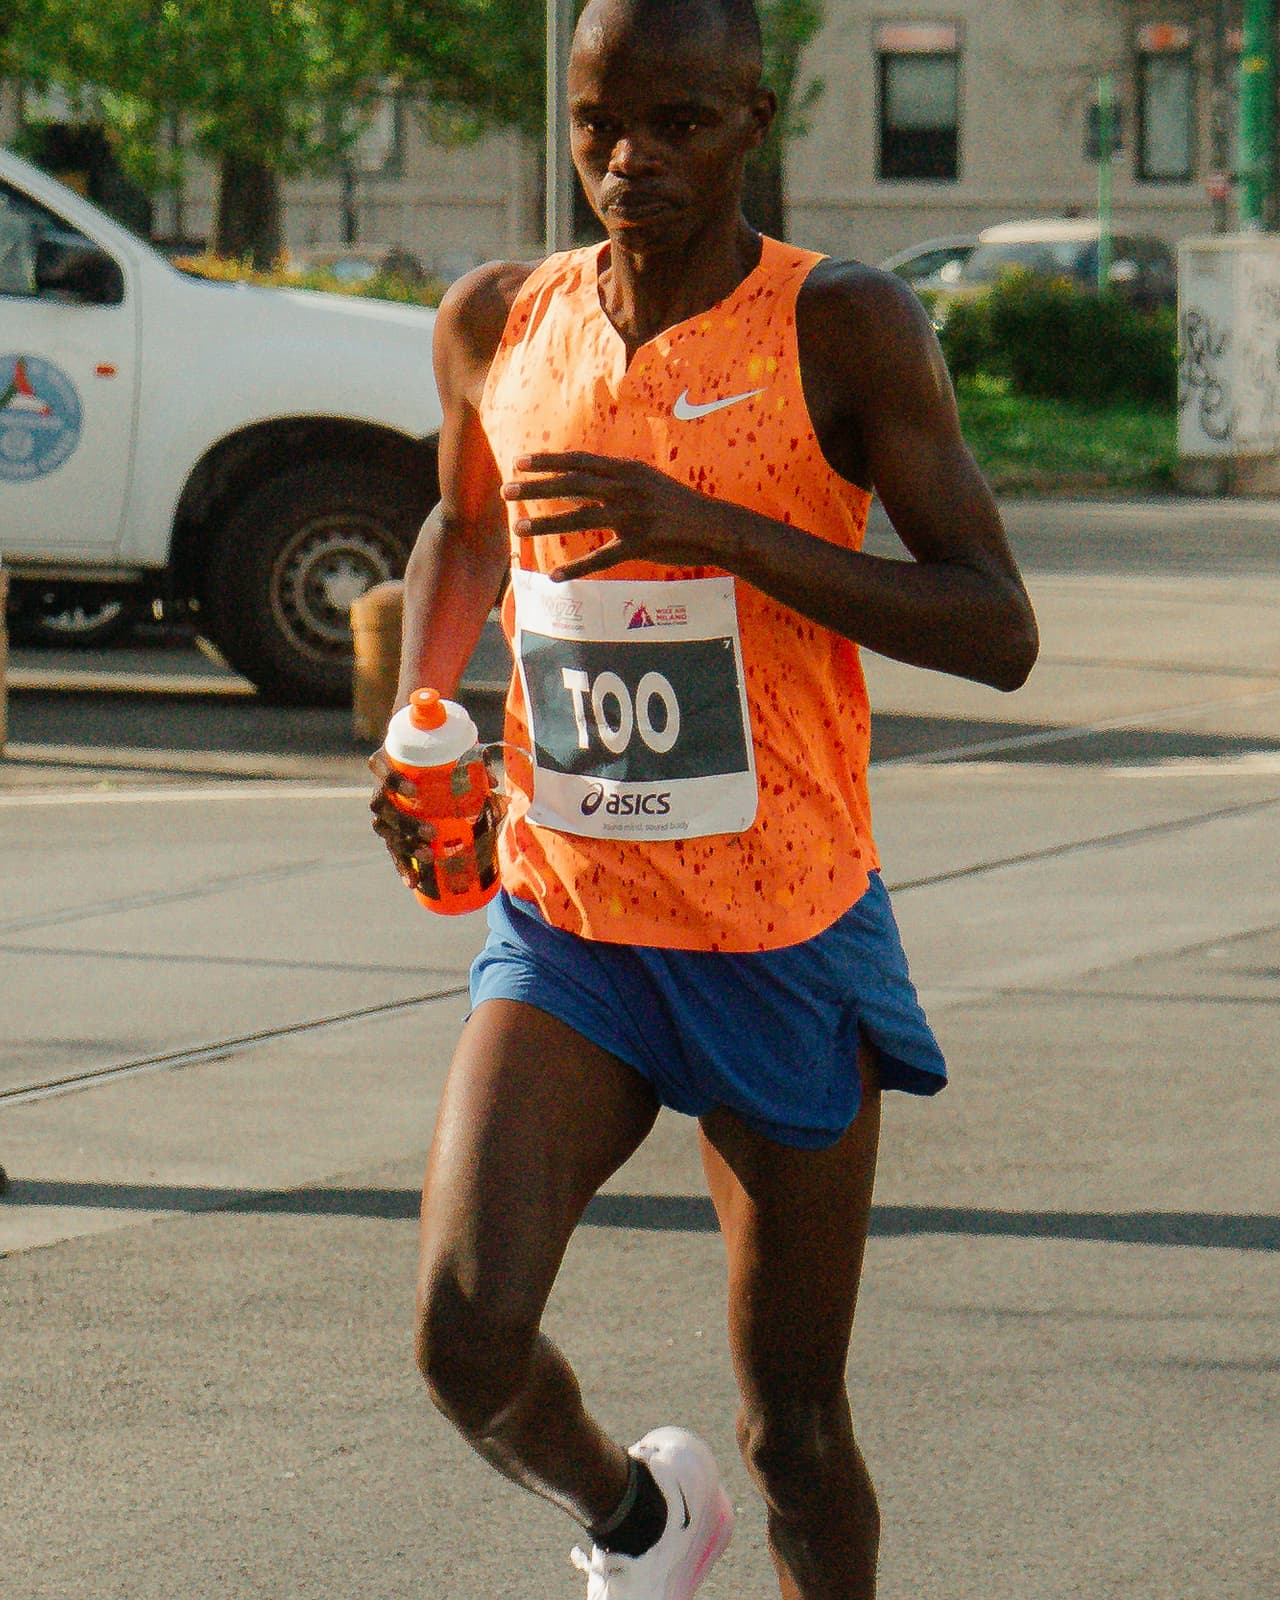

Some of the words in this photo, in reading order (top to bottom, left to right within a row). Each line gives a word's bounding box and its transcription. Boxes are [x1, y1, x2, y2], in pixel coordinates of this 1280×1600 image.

[723, 639, 731, 649] 7
[562, 666, 680, 754] TOO
[605, 792, 672, 816] asics
